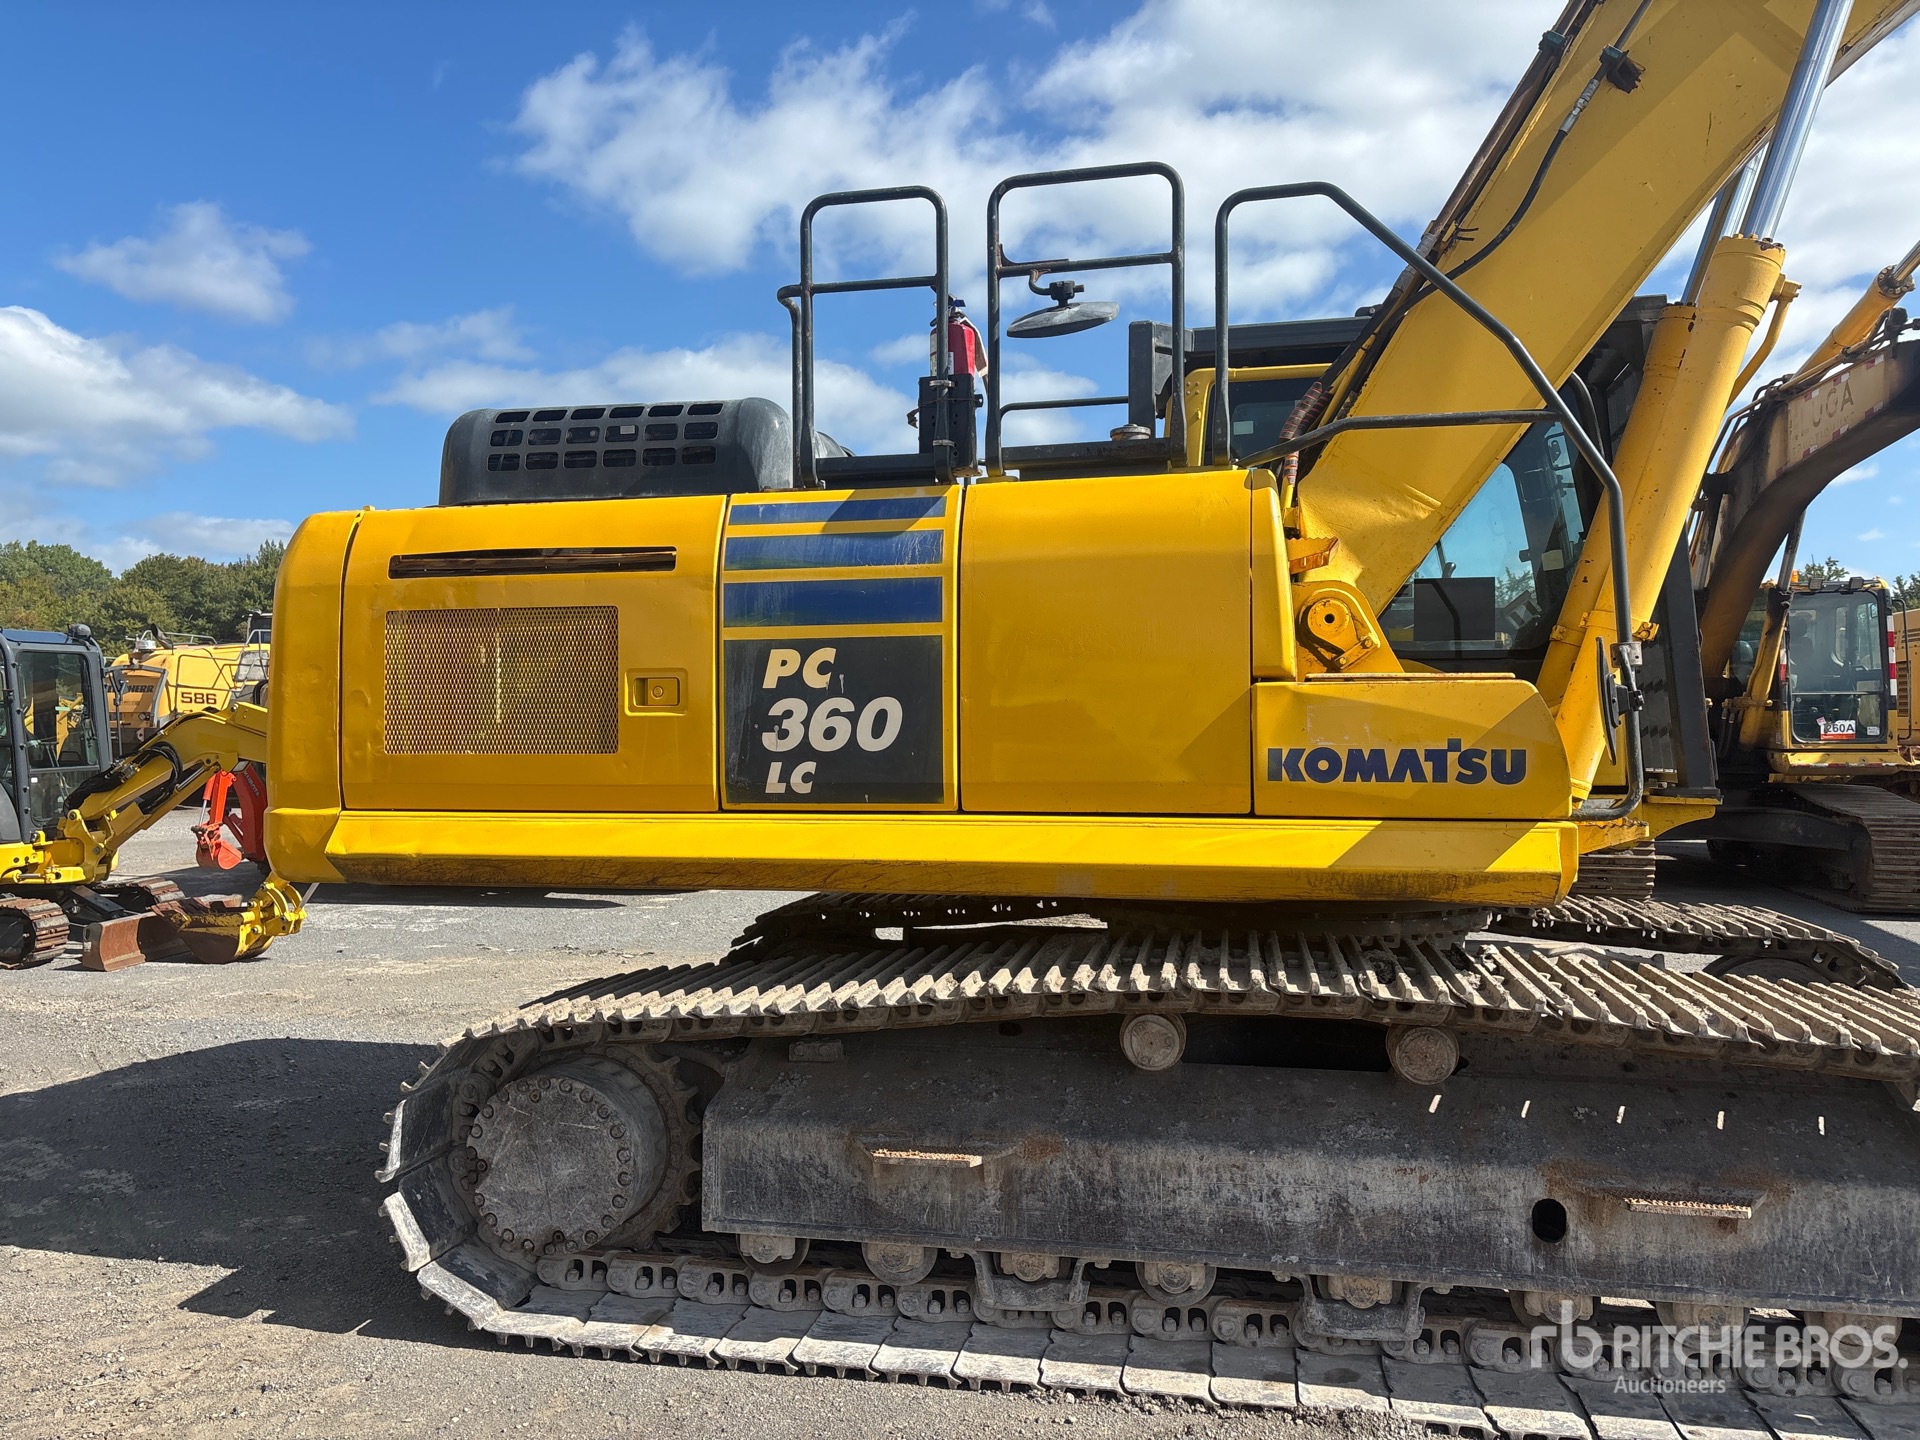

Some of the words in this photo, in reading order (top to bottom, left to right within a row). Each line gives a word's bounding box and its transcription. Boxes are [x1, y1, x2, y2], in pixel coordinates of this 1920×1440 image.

[762, 647, 837, 689] PC
[181, 691, 217, 705] 586
[761, 696, 903, 752] 360
[765, 761, 817, 794] LC
[1268, 738, 1527, 784] KOMATSU
